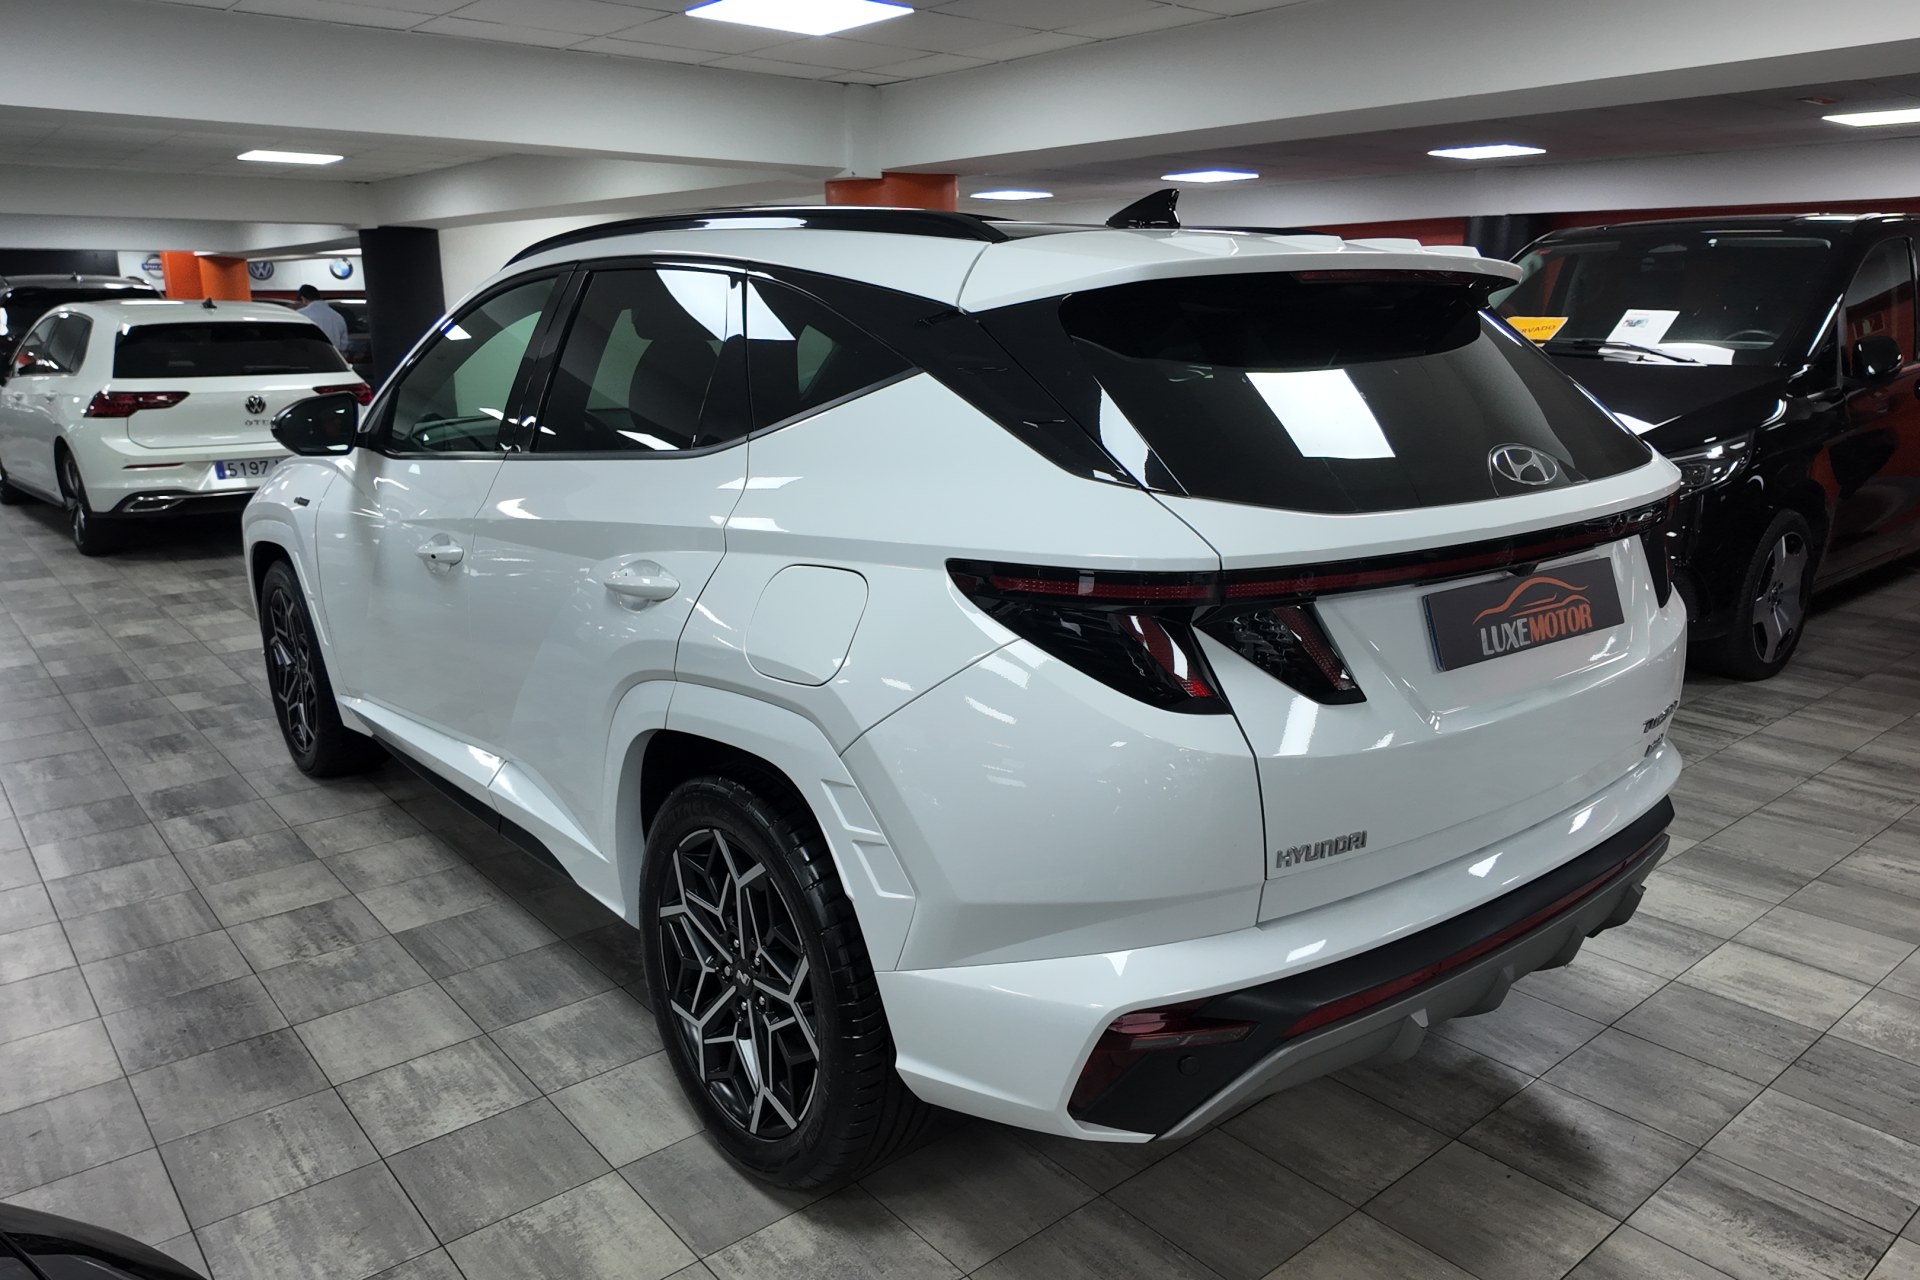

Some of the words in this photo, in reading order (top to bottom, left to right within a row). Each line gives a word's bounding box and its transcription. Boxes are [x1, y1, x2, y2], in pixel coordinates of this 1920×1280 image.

[1521, 324, 1557, 334] RVADO
[227, 460, 268, 477] 5197
[1480, 604, 1593, 656] LUXEMOTOR
[1276, 830, 1368, 869] HYUNDAI
